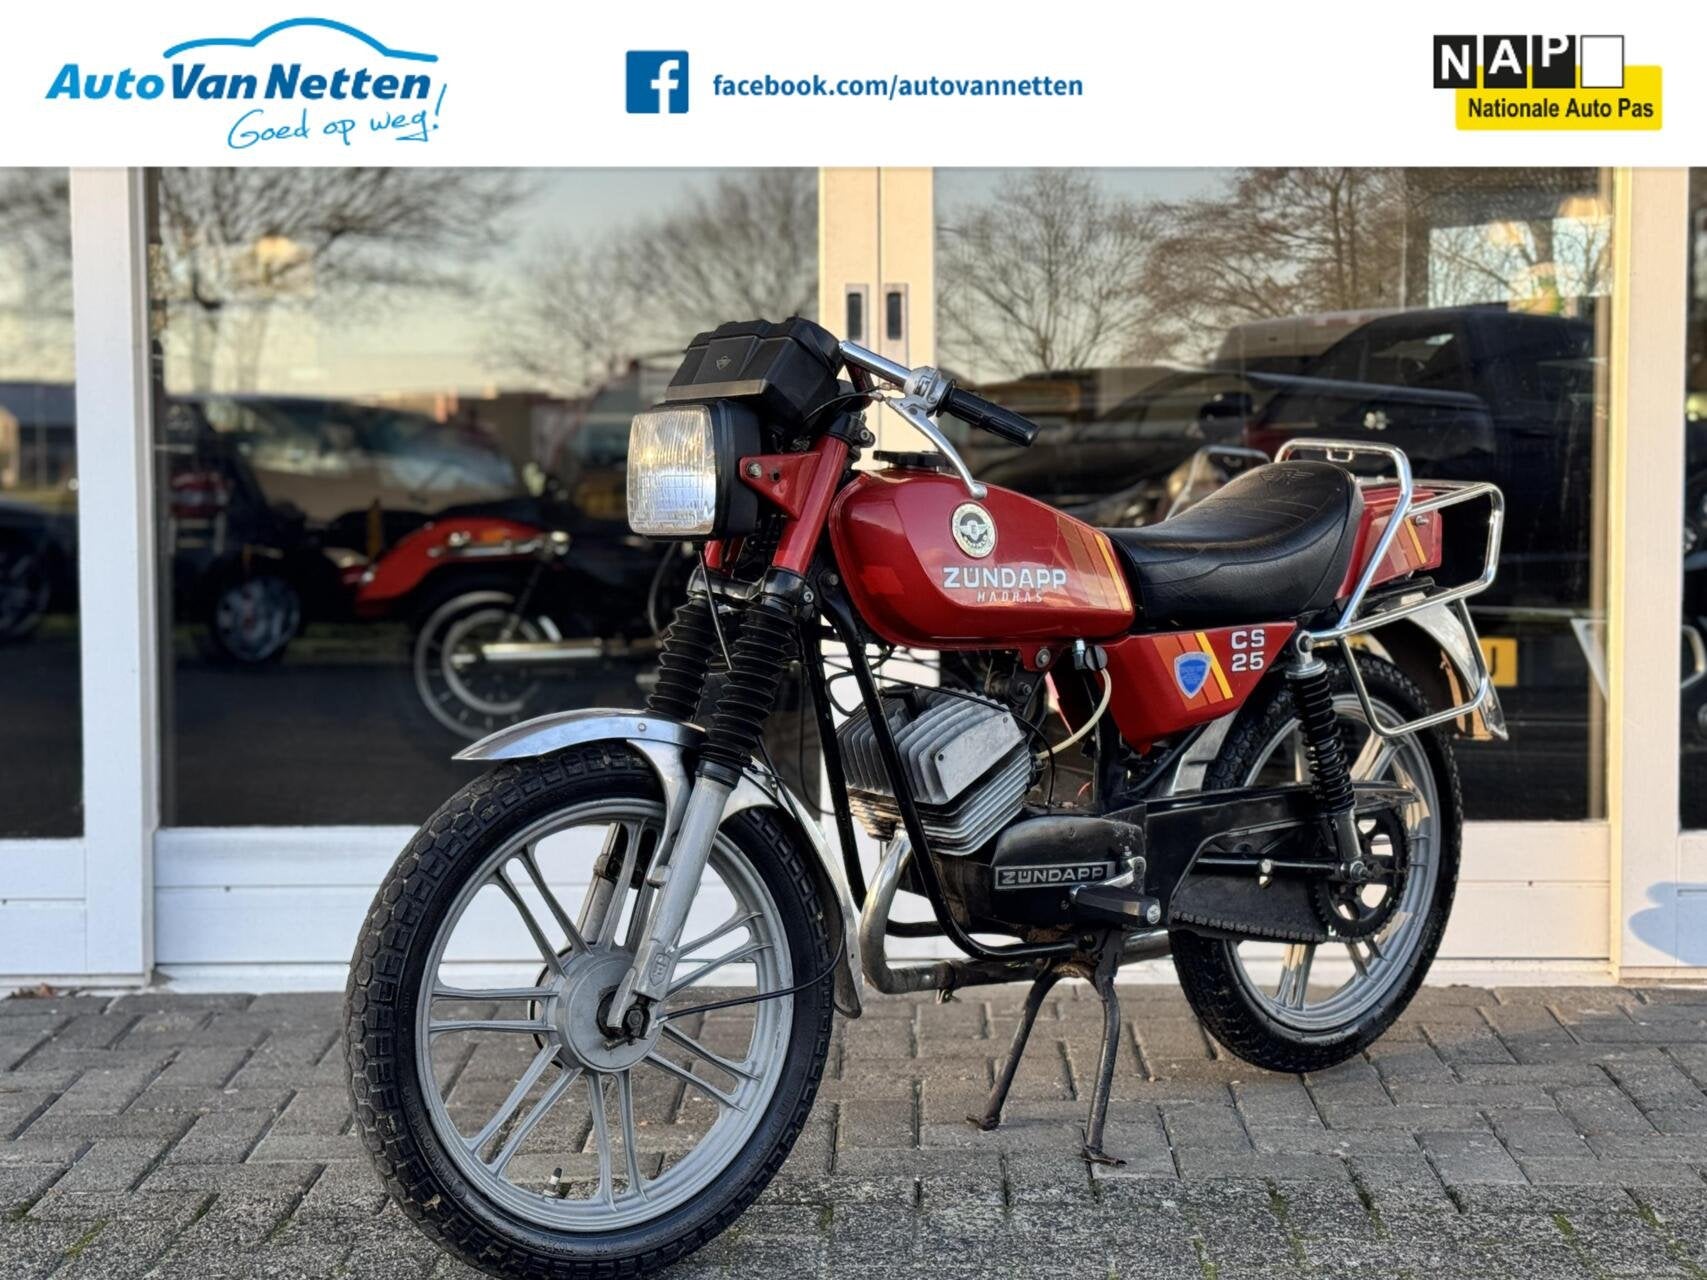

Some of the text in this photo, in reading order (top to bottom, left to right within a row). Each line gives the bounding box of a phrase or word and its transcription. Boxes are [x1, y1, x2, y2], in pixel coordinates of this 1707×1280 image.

[943, 567, 1067, 589] ZÜNDAPP
[1231, 629, 1265, 650] CS
[1231, 651, 1265, 672] 25
[1001, 867, 1104, 885] ZÜNDAPP
